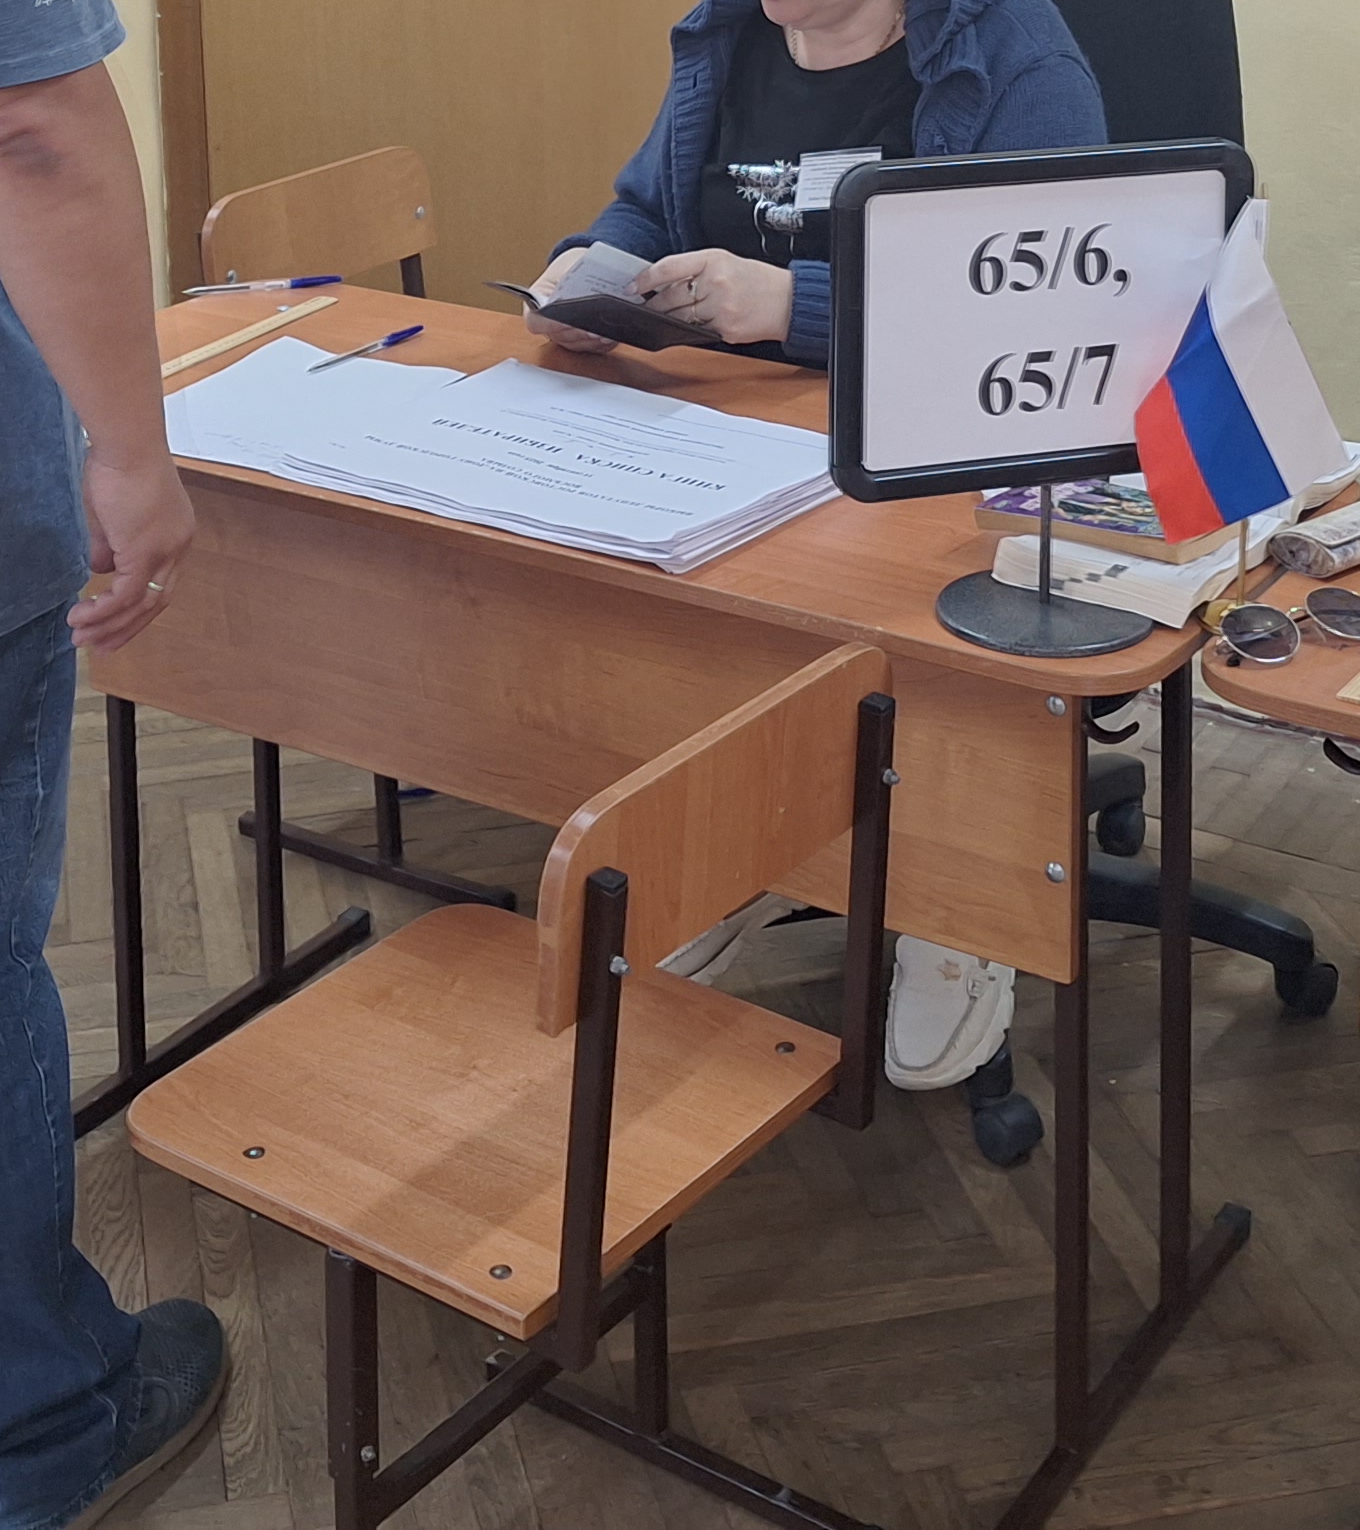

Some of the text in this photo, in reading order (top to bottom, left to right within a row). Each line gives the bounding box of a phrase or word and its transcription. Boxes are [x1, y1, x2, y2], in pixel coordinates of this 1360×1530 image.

[968, 223, 1132, 297] 65/6,
[978, 343, 1120, 416] 65/7
[431, 418, 727, 491] КНИГА СПИСКА ИЗБИРАТЕЛЕЙ
